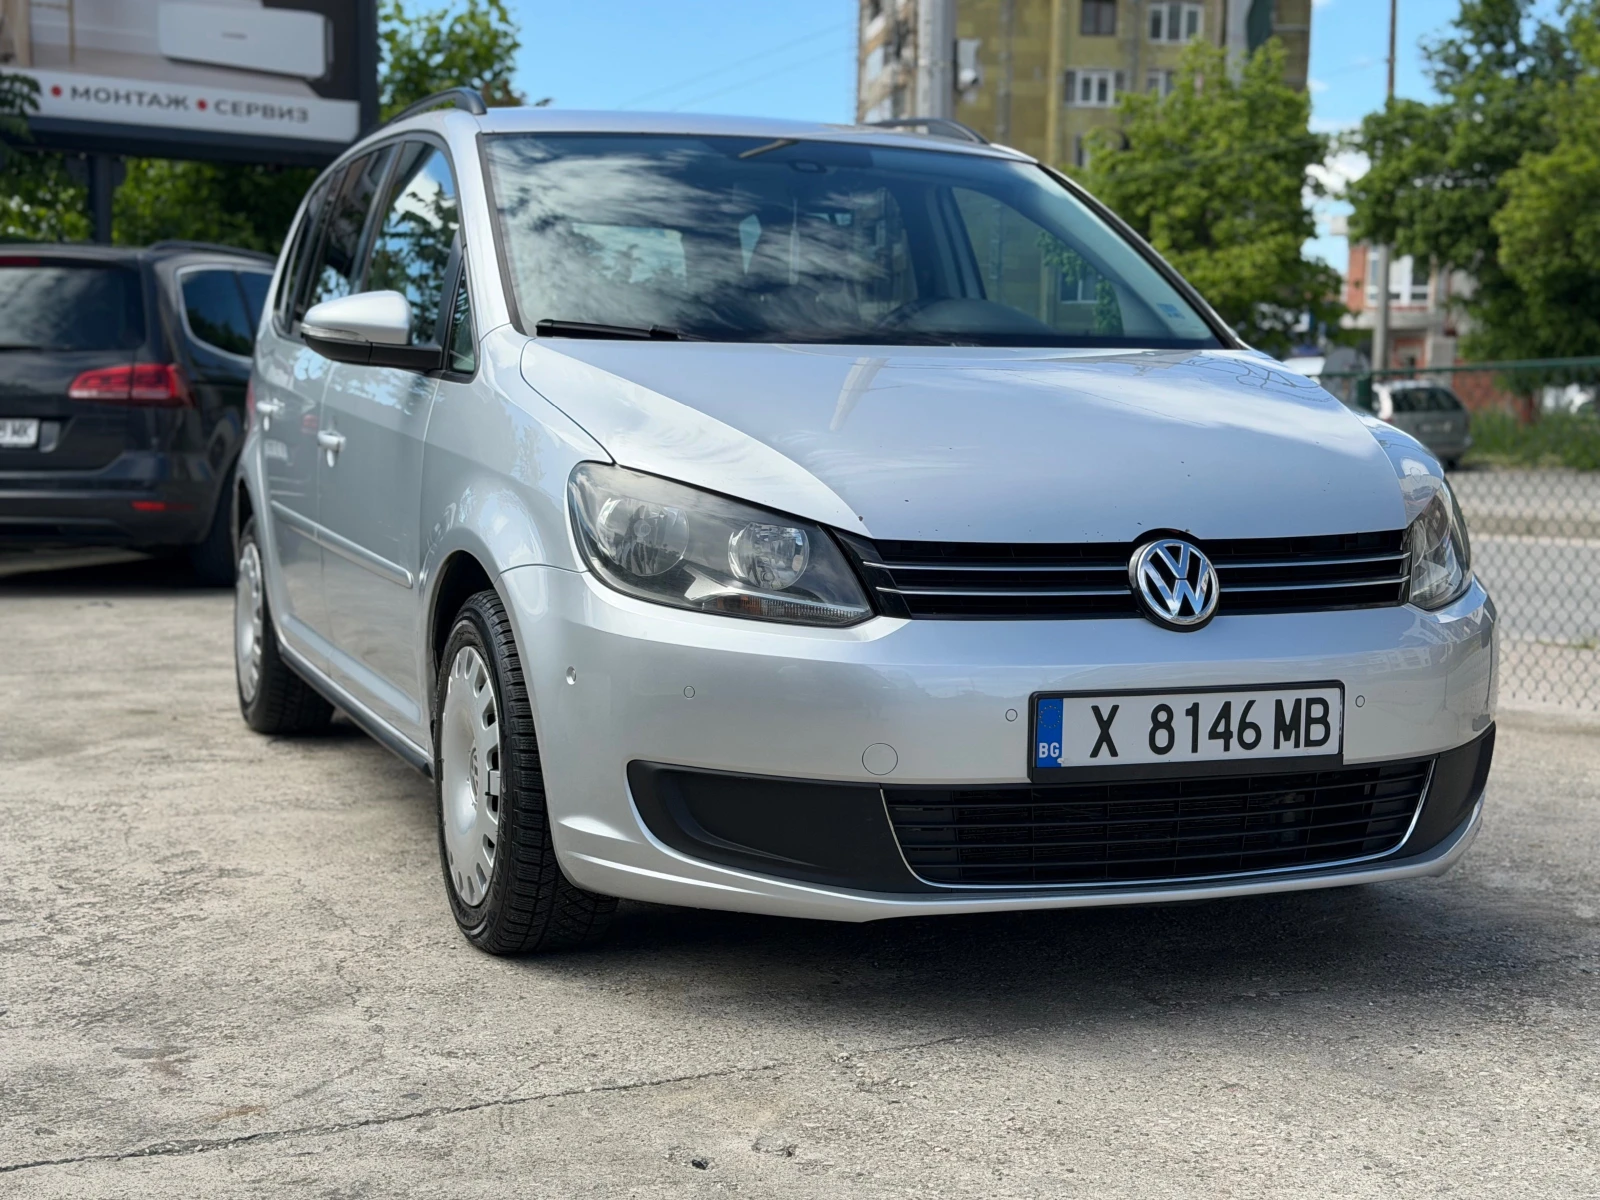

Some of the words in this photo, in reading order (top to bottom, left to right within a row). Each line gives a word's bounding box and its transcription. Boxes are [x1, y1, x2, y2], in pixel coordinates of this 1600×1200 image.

[71, 86, 189, 110] МОНТАЖ
[214, 99, 309, 123] СЕРВИЗ
[1089, 704, 1120, 758] X
[1148, 700, 1262, 755] 8146
[1273, 697, 1331, 750] MB
[1038, 742, 1060, 758] BG
